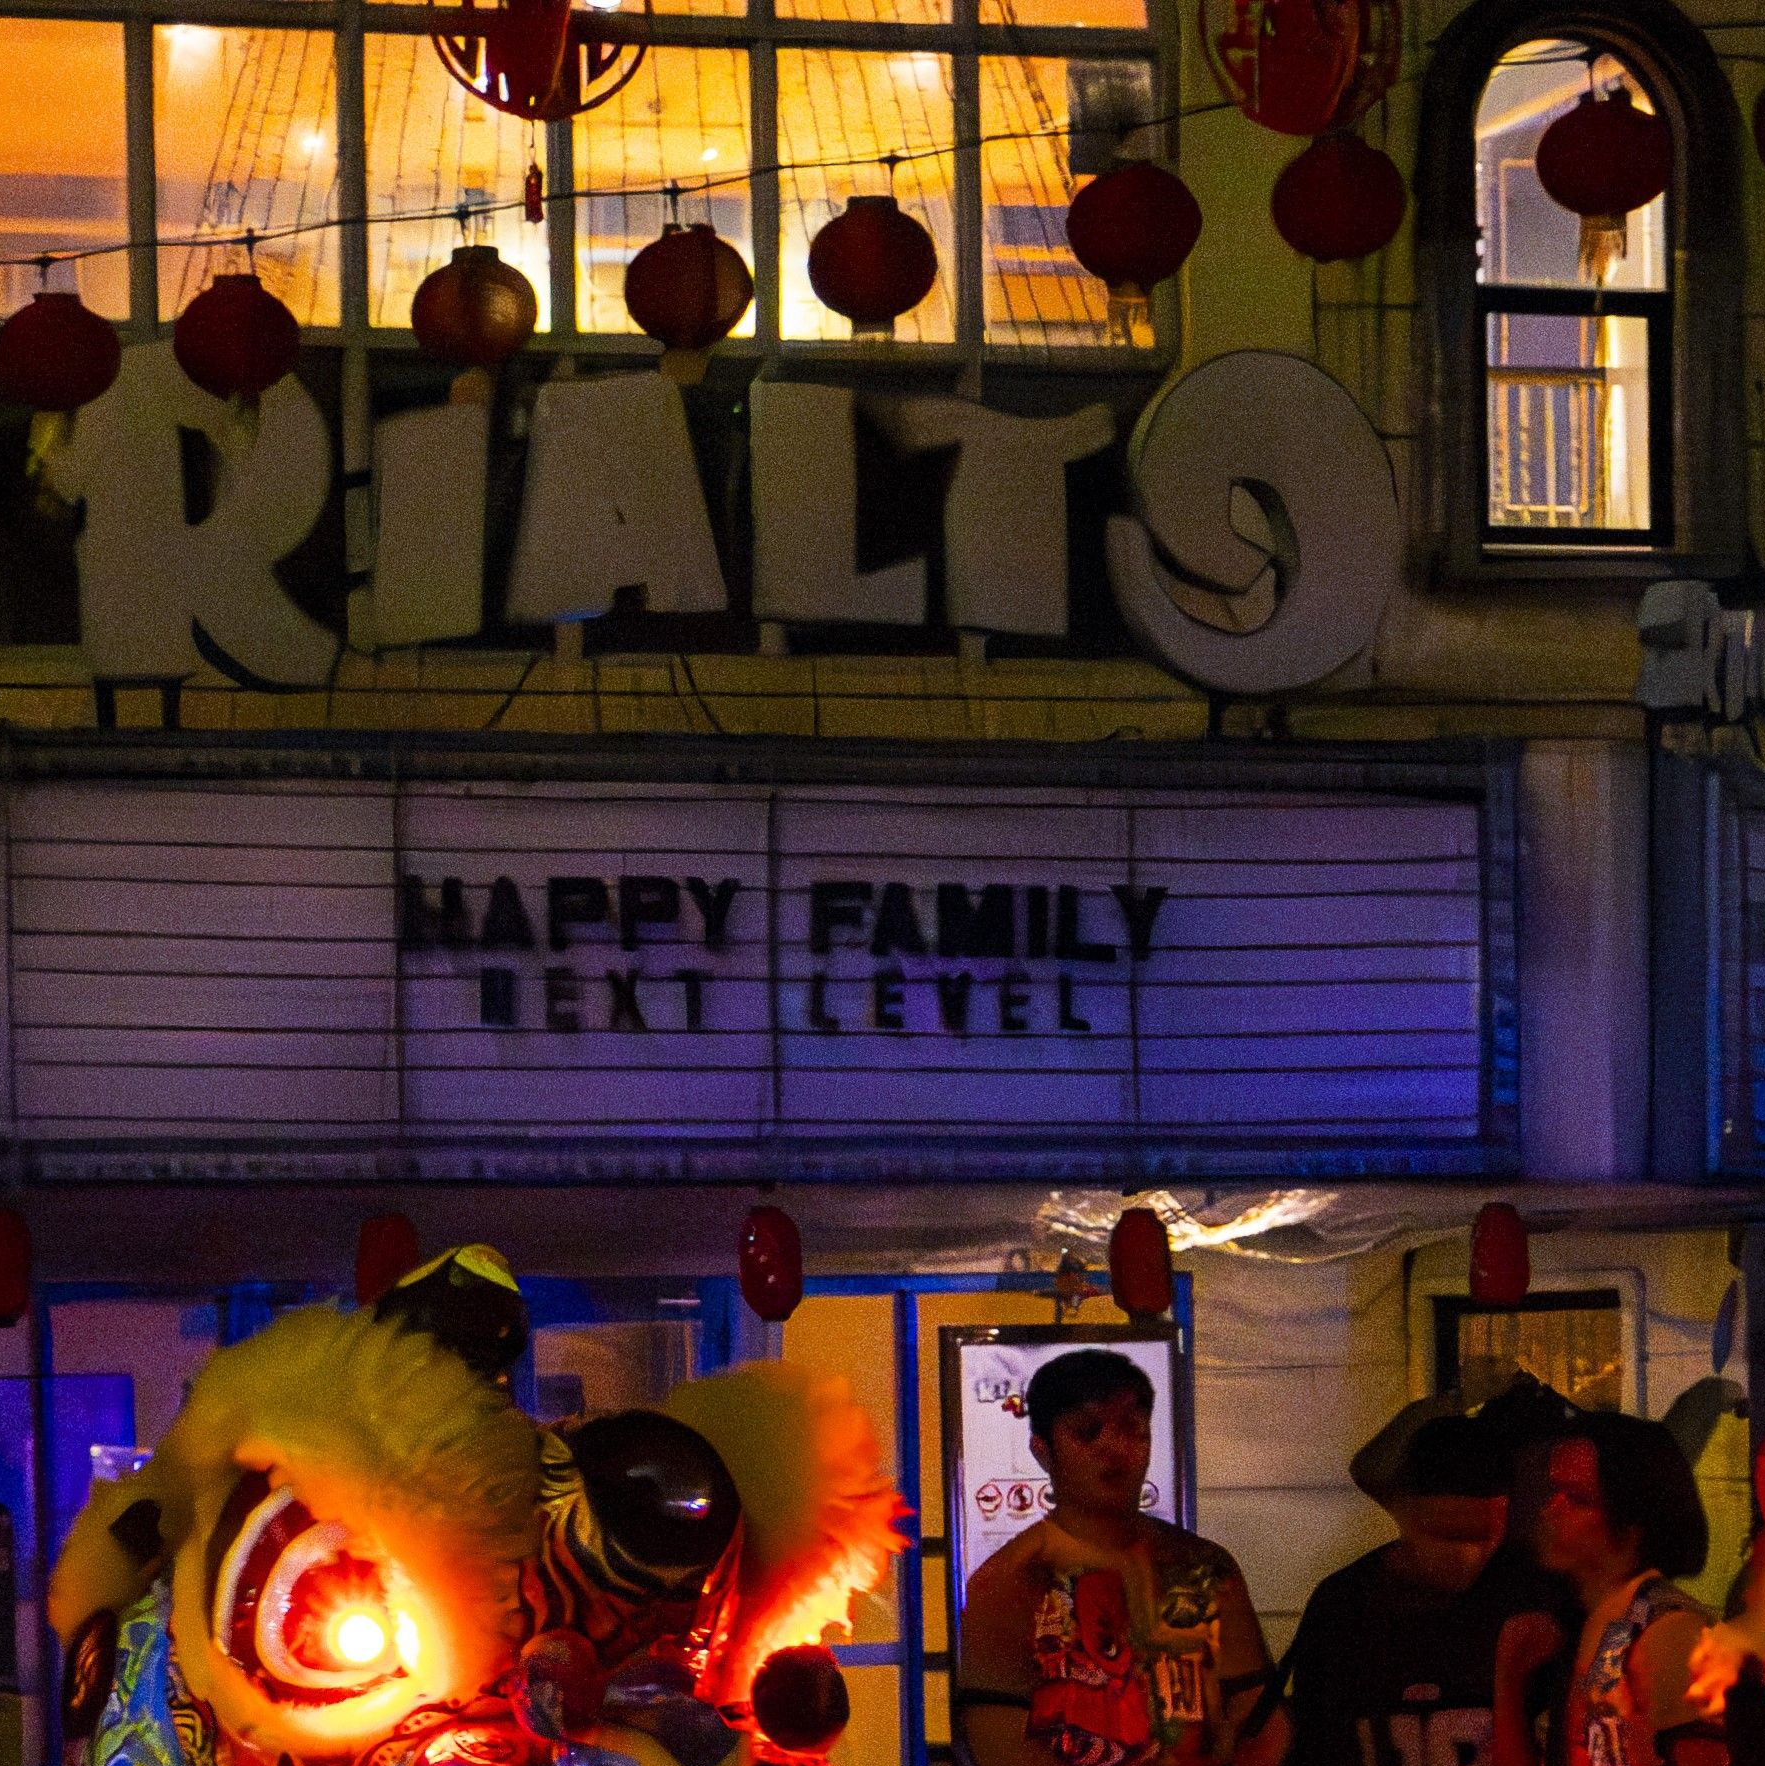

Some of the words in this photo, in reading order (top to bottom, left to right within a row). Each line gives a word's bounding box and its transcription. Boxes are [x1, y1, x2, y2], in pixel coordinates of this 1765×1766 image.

[74, 338, 1402, 695] RIALTO
[401, 874, 741, 952] HAPPY
[812, 881, 1169, 961] FAMILY
[808, 967, 1091, 1038] LEVEL
